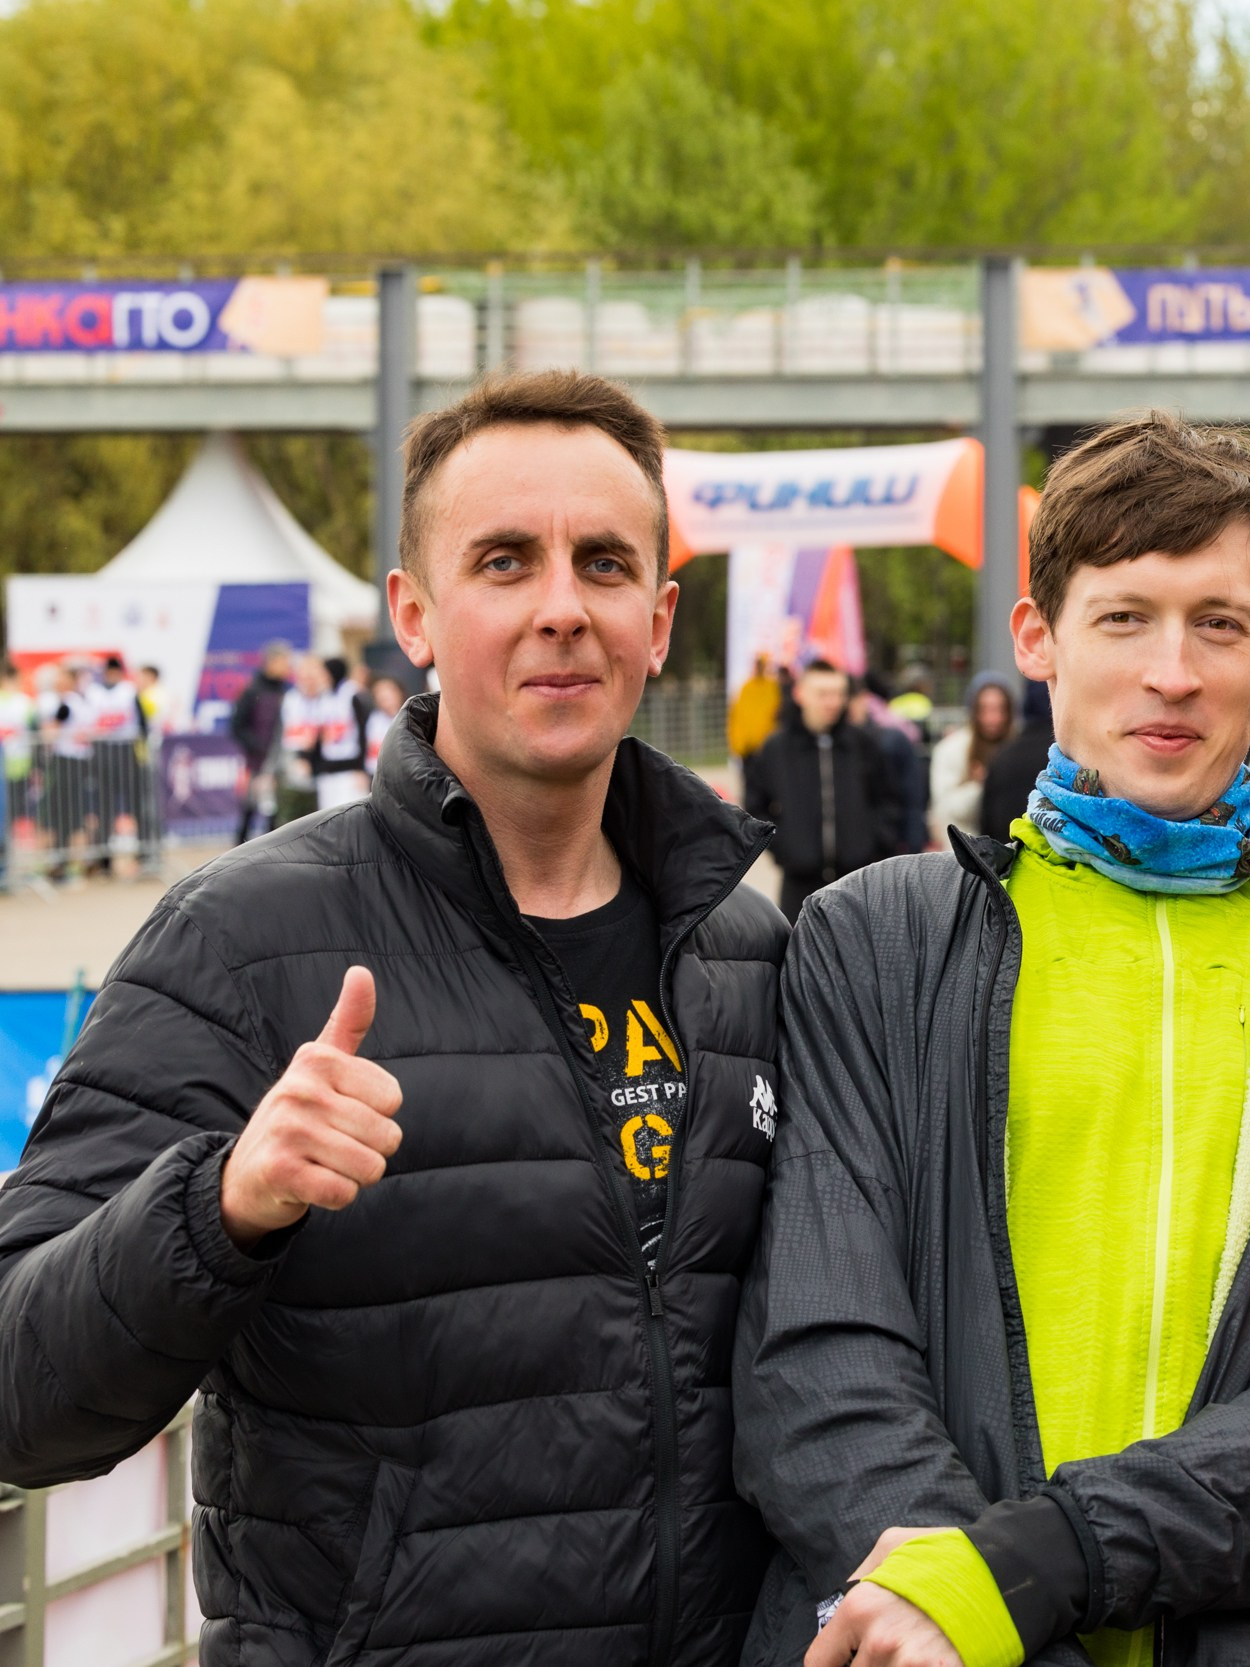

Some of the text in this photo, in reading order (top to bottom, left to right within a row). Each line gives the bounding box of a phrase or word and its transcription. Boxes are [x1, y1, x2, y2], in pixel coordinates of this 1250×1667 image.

[692, 473, 919, 513] ФИНИШ
[611, 1084, 660, 1107] GEST
[752, 1107, 778, 1143] Kapp
